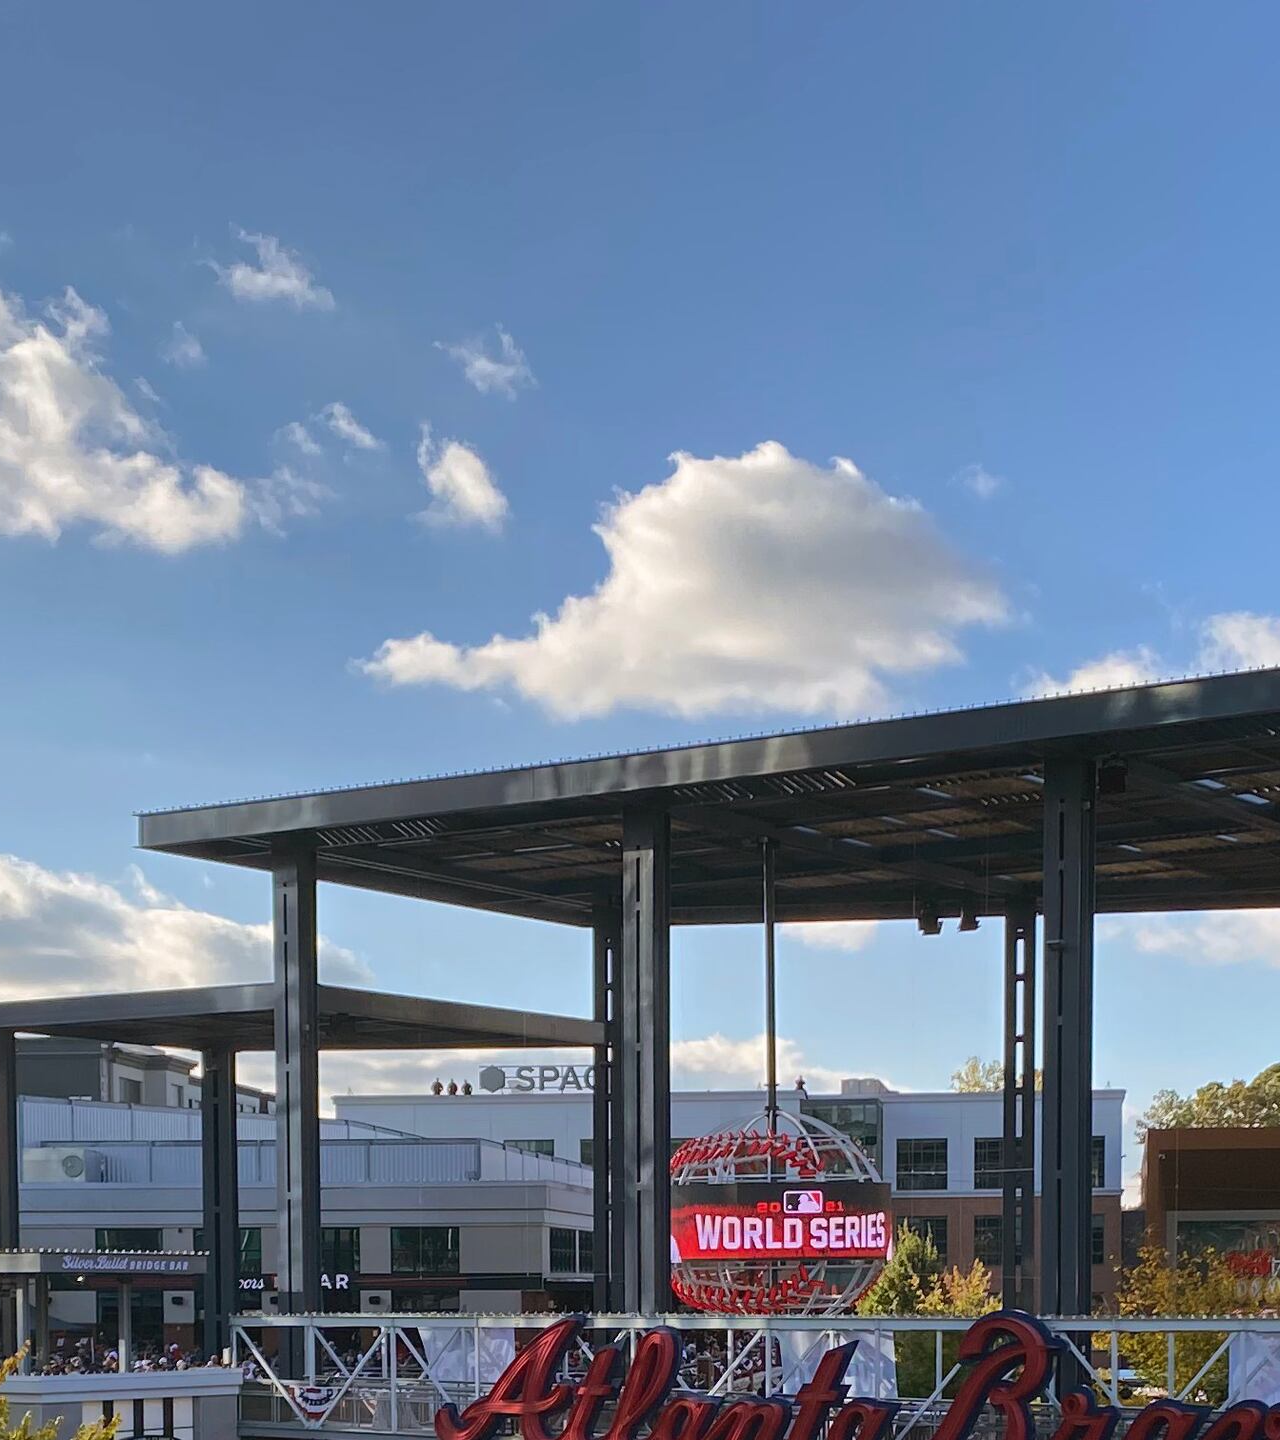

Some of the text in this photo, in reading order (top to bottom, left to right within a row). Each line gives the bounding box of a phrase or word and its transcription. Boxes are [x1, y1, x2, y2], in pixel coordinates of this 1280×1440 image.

[695, 1211, 886, 1250] WORLD SERIES
[61, 1256, 94, 1271] Silver
[130, 1260, 166, 1272] BRIDGE
[169, 1261, 189, 1271] BAR
